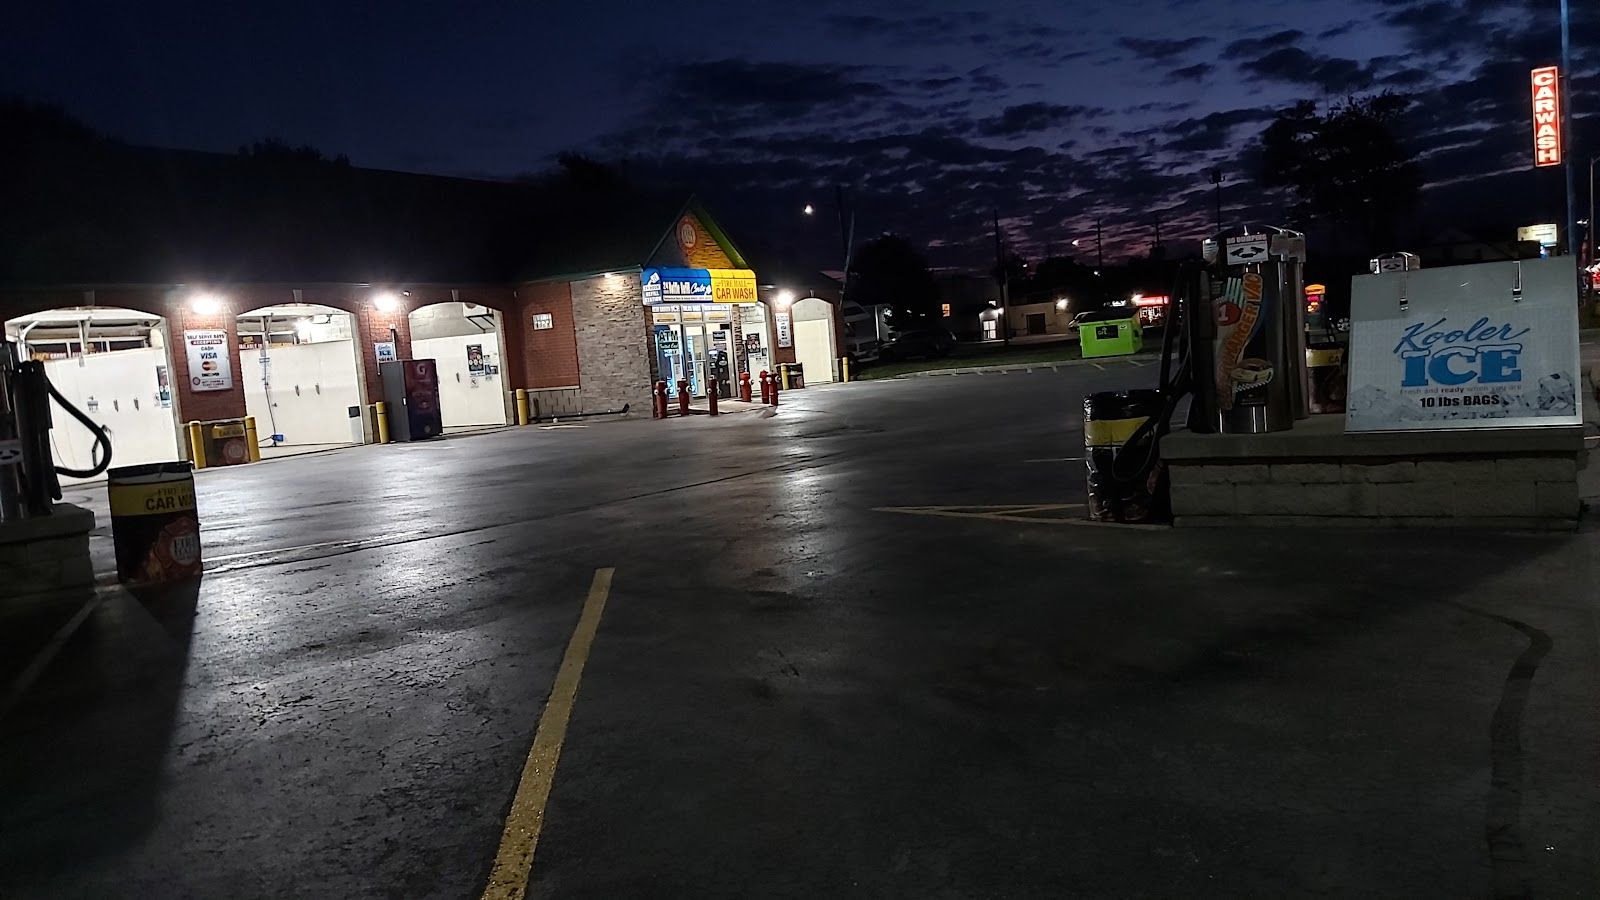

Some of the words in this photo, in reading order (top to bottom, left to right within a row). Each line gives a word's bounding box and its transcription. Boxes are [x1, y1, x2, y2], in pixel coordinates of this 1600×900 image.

[716, 287, 731, 299] CAR
[732, 287, 754, 300] WASH
[1243, 274, 1263, 304] VAC
[660, 330, 679, 341] ATM
[1393, 317, 1531, 353] Kooler
[200, 352, 217, 360] VISA
[1401, 343, 1523, 387] ICE
[1440, 387, 1465, 395] ready
[1420, 397, 1435, 408] 10
[1438, 396, 1460, 407] lbs
[1463, 395, 1501, 406] BAGS
[146, 496, 176, 511] CAR
